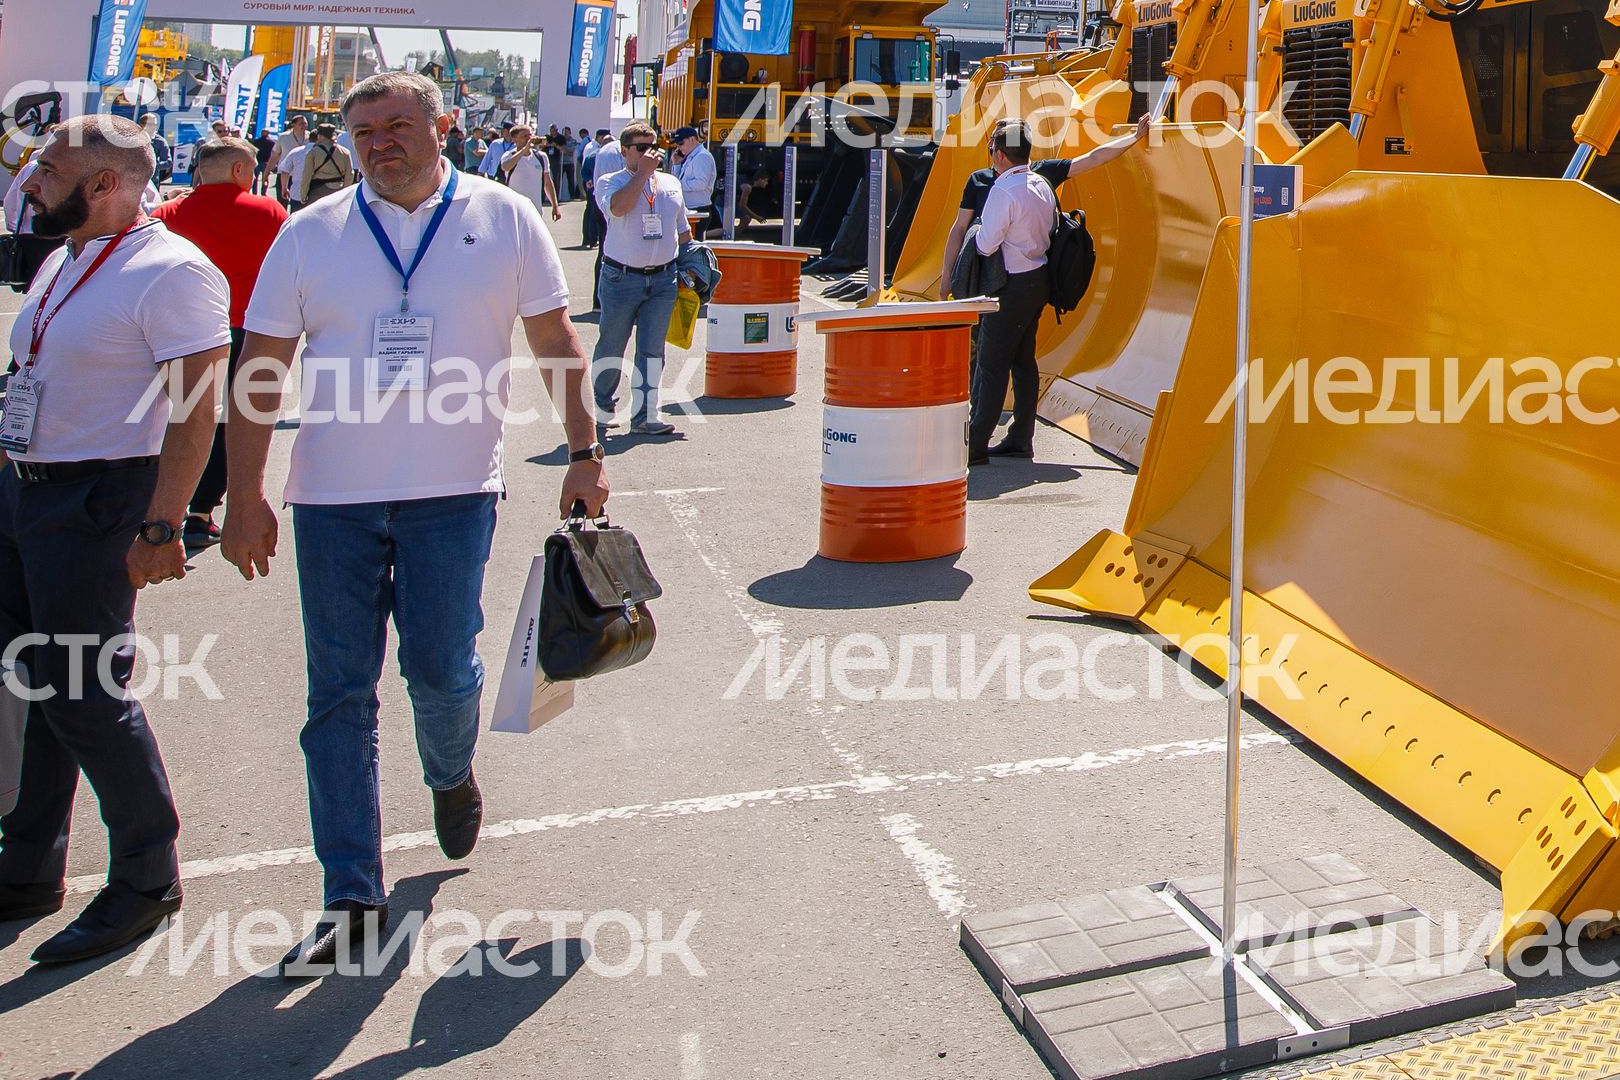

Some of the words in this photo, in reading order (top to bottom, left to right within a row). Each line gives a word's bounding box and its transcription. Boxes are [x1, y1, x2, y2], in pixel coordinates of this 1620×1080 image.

[243, 2, 291, 11] СУРОВЫЙ
[318, 5, 371, 14] НАДЕЖНАЯ
[374, 6, 416, 15] ТЕХНИКА
